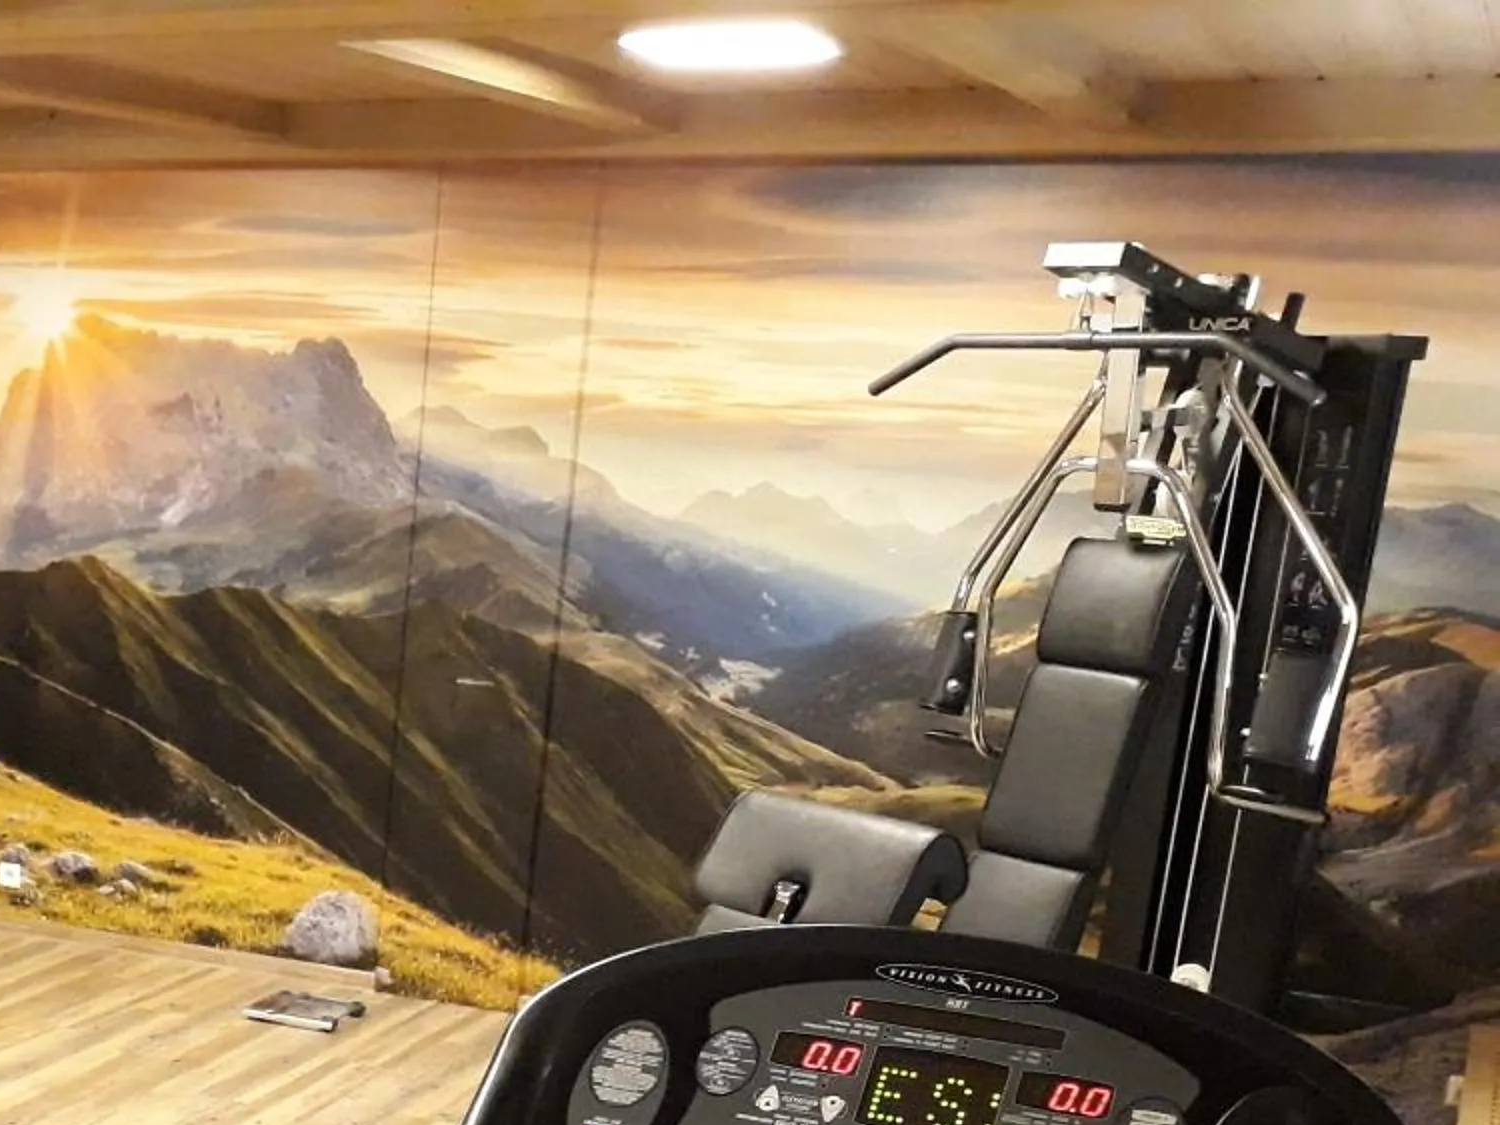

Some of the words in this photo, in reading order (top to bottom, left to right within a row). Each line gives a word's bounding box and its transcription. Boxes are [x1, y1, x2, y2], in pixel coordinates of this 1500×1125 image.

[1188, 317, 1250, 331] UNICA
[889, 968, 947, 984] VISION
[975, 981, 1044, 999] FITNESS
[802, 1040, 861, 1075] 0.0
[1047, 1082, 1112, 1118] 0.0
